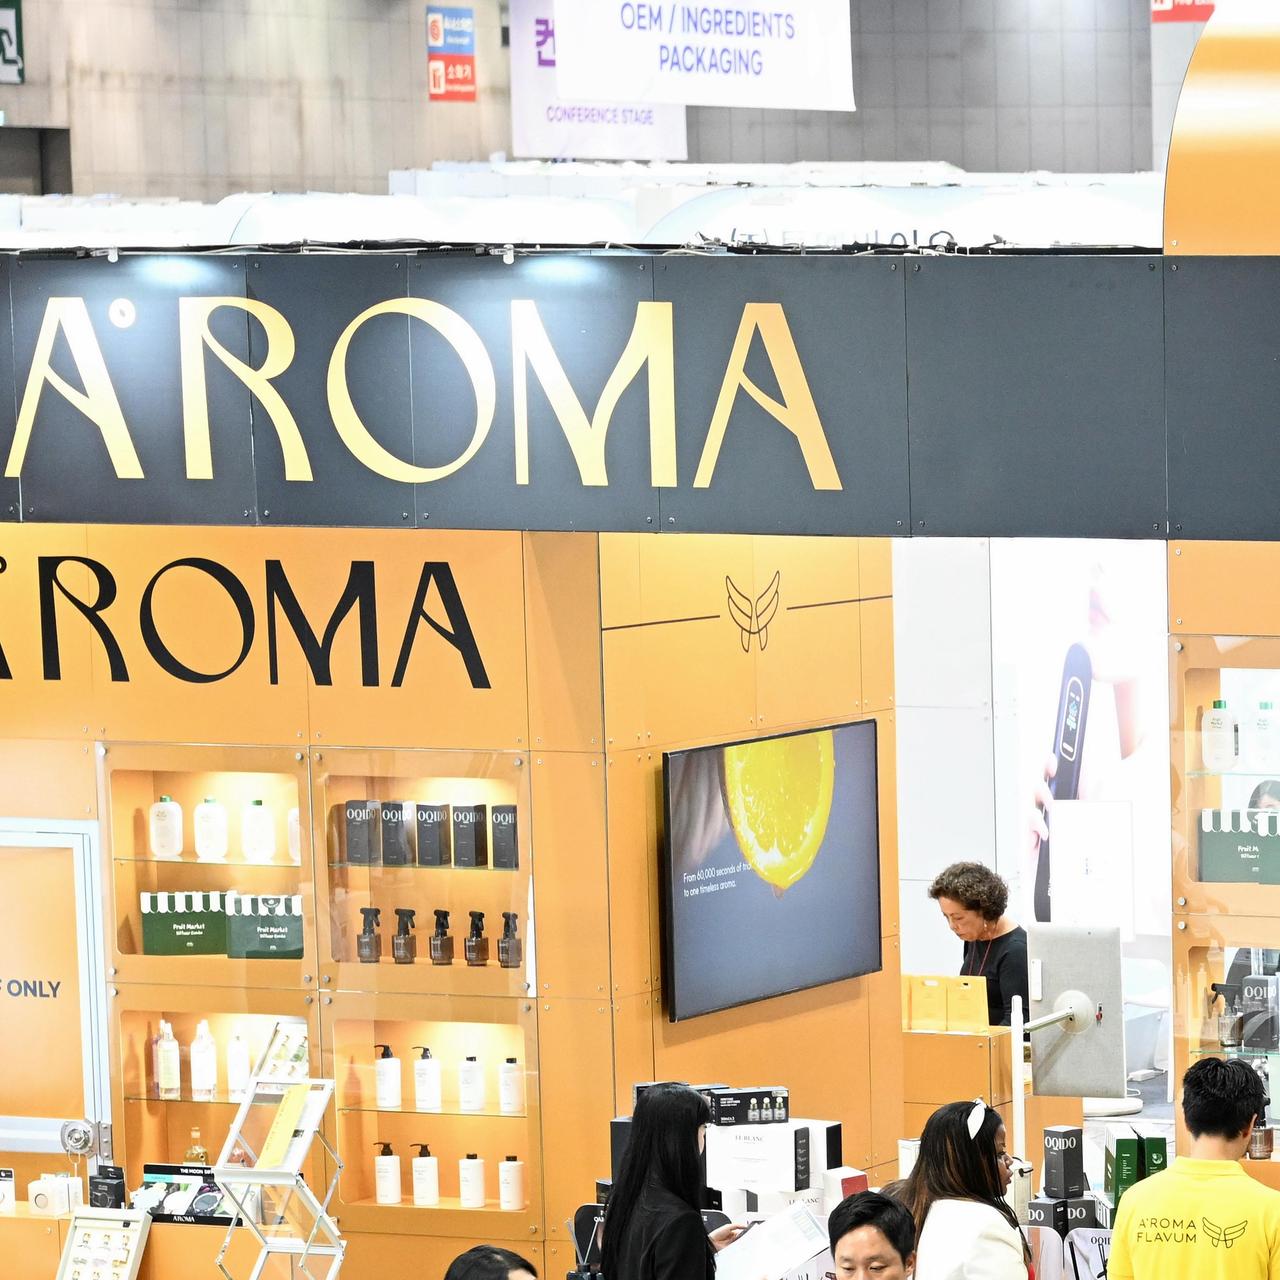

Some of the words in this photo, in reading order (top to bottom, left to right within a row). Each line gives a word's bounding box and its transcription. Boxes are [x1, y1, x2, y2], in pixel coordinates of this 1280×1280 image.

[620, 2, 663, 32] OEM
[681, 6, 796, 39] INGREDIENTS
[659, 45, 763, 76] PACKAGING
[546, 105, 619, 124] CONFERENCE
[622, 109, 654, 125] STAGE
[7, 979, 61, 998] ONLY
[1044, 1136, 1076, 1150] OQIDO
[1139, 1218, 1196, 1230] A'ROMA
[1136, 1232, 1197, 1244] FLAVUM
